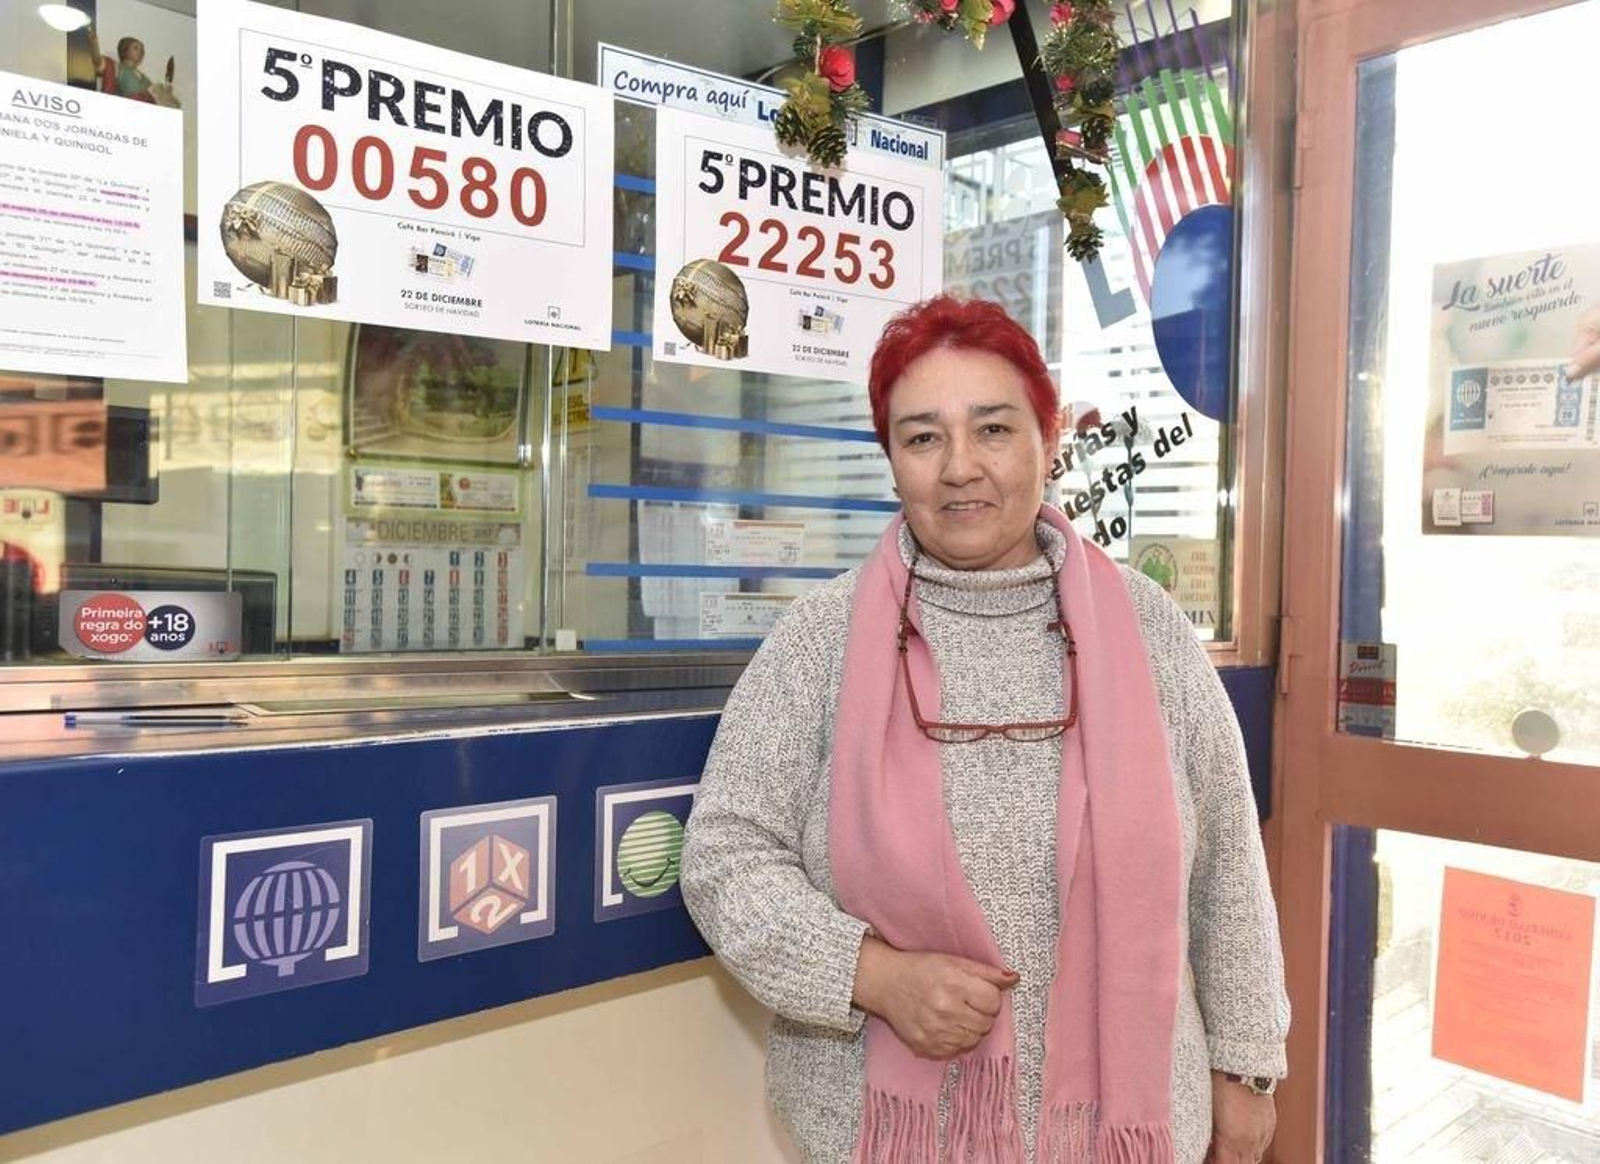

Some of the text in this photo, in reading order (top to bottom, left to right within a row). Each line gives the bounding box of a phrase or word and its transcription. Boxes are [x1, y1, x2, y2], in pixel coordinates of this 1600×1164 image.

[12, 89, 82, 115] AVISO
[321, 58, 574, 159] PREMIO
[614, 70, 698, 103] Compra
[706, 89, 750, 112] aquí
[871, 129, 929, 160] Nacional
[0, 127, 113, 155] NIELA Y QUINIGOL
[34, 117, 60, 130] DOS
[63, 124, 130, 144] JORNADAS
[132, 135, 148, 147] DE
[293, 124, 548, 227] 00580
[738, 156, 915, 231] PREMIO
[717, 211, 896, 290] 22253
[1442, 253, 1568, 311] La suerte
[400, 289, 483, 307] 22 DE DICIEMBRE
[403, 302, 481, 318] SORTEO DE NAVIDAD
[792, 344, 801, 352] 22
[814, 347, 850, 358] DICIEMBRE
[1121, 405, 1138, 438] y
[1154, 412, 1194, 458] del
[377, 521, 470, 542] DICIEMBRE
[80, 619, 143, 632] regra do
[81, 606, 143, 619] Primeira
[148, 613, 190, 632] +18
[91, 632, 133, 644] xogo:
[150, 632, 186, 642] anos
